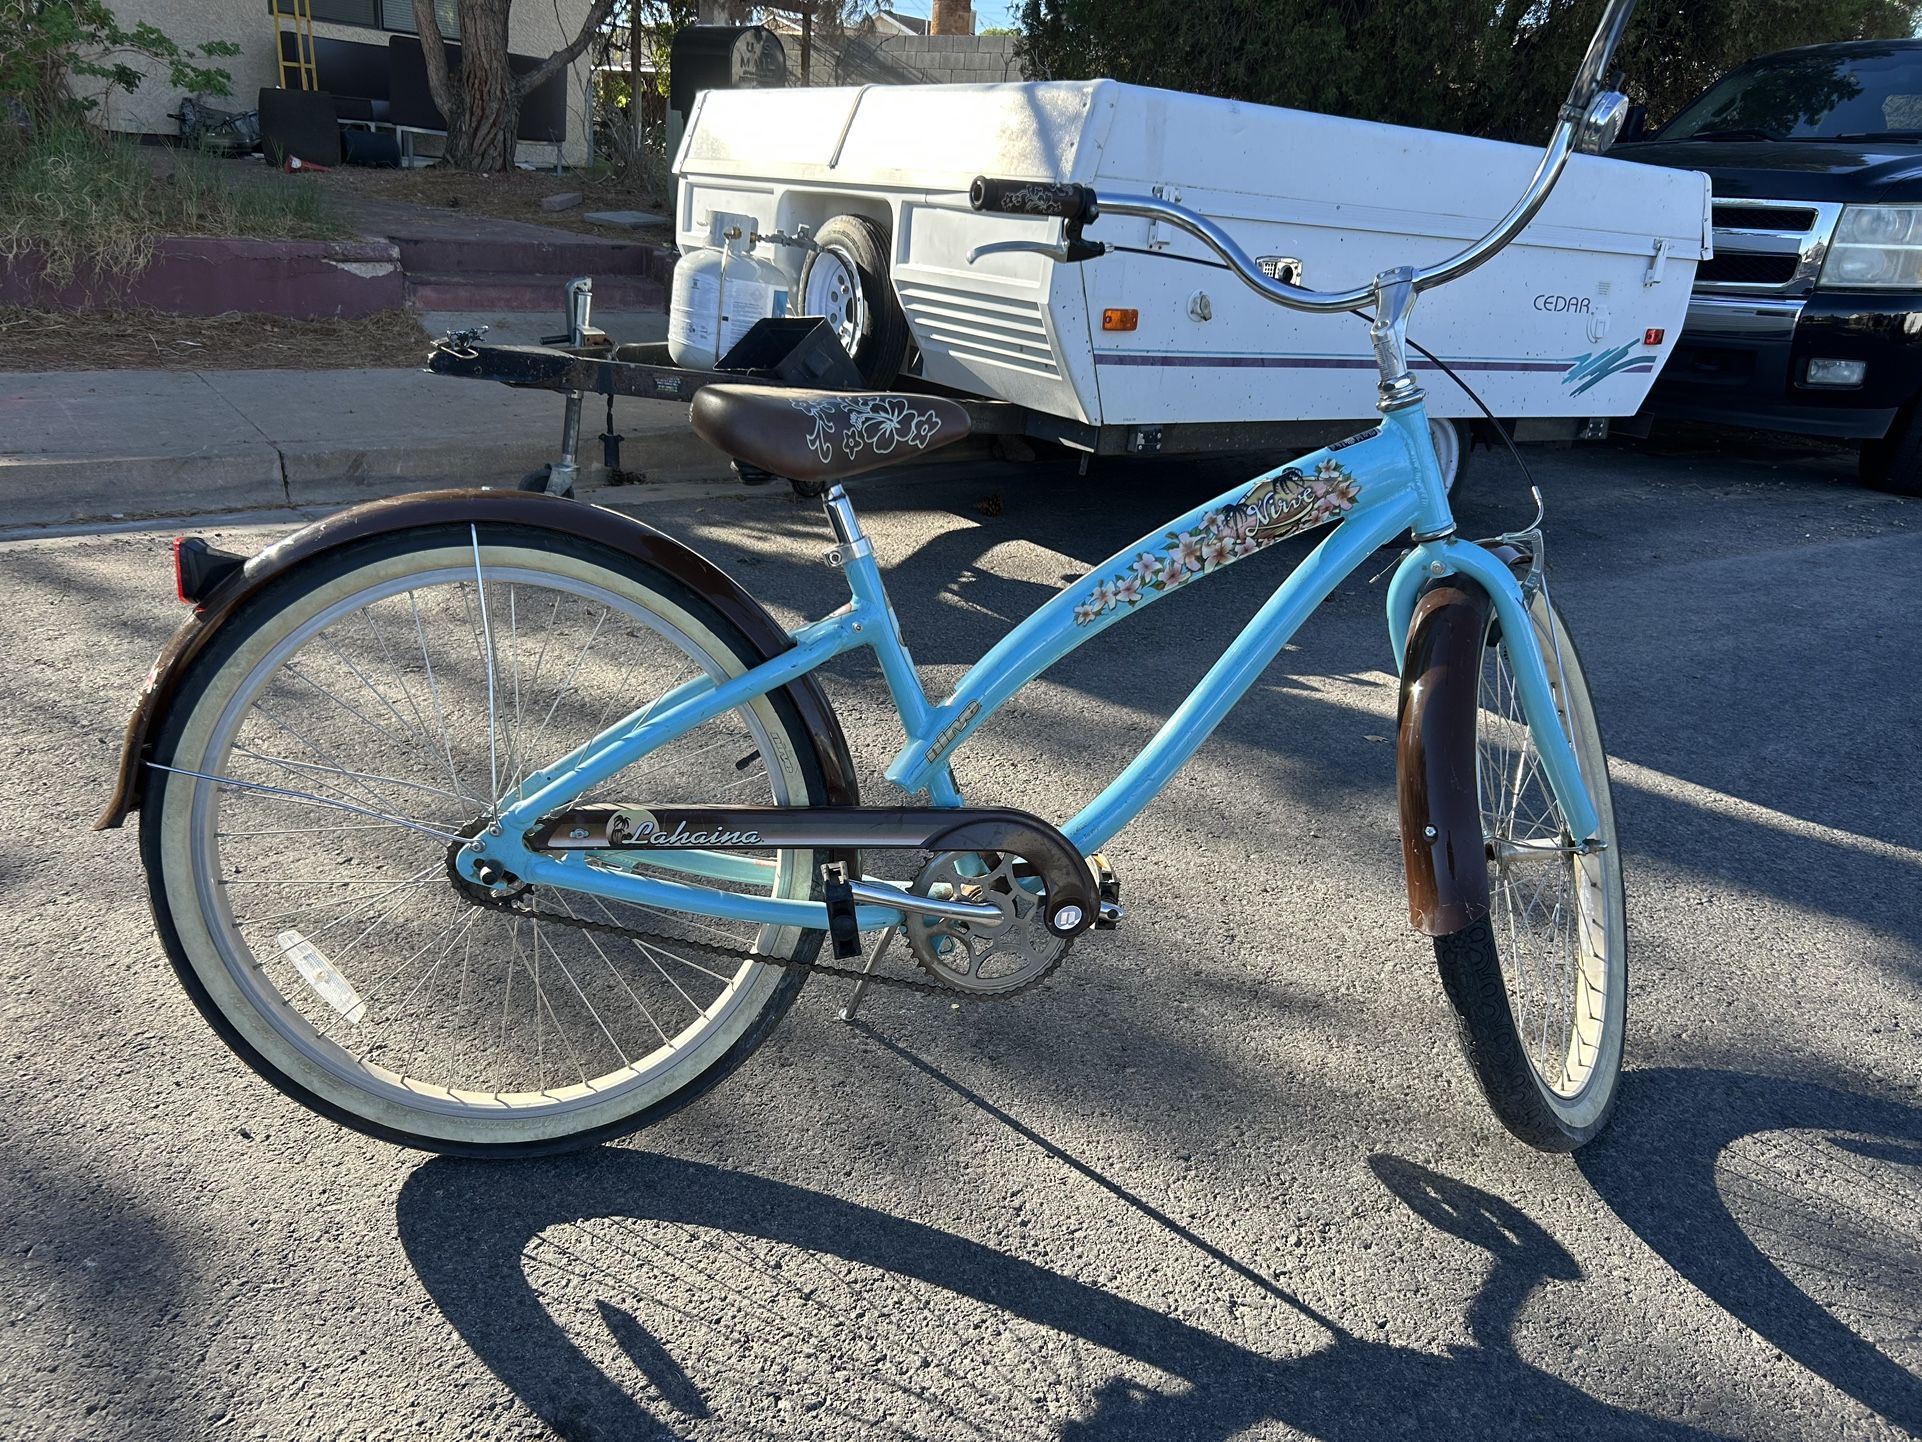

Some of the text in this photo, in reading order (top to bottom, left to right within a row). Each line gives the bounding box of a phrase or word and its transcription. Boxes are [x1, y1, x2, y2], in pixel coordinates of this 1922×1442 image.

[740, 55, 777, 70] MAIL
[1533, 294, 1591, 314] CEDAR
[1246, 485, 1317, 536] Nirve
[622, 820, 762, 845] Lahaina
